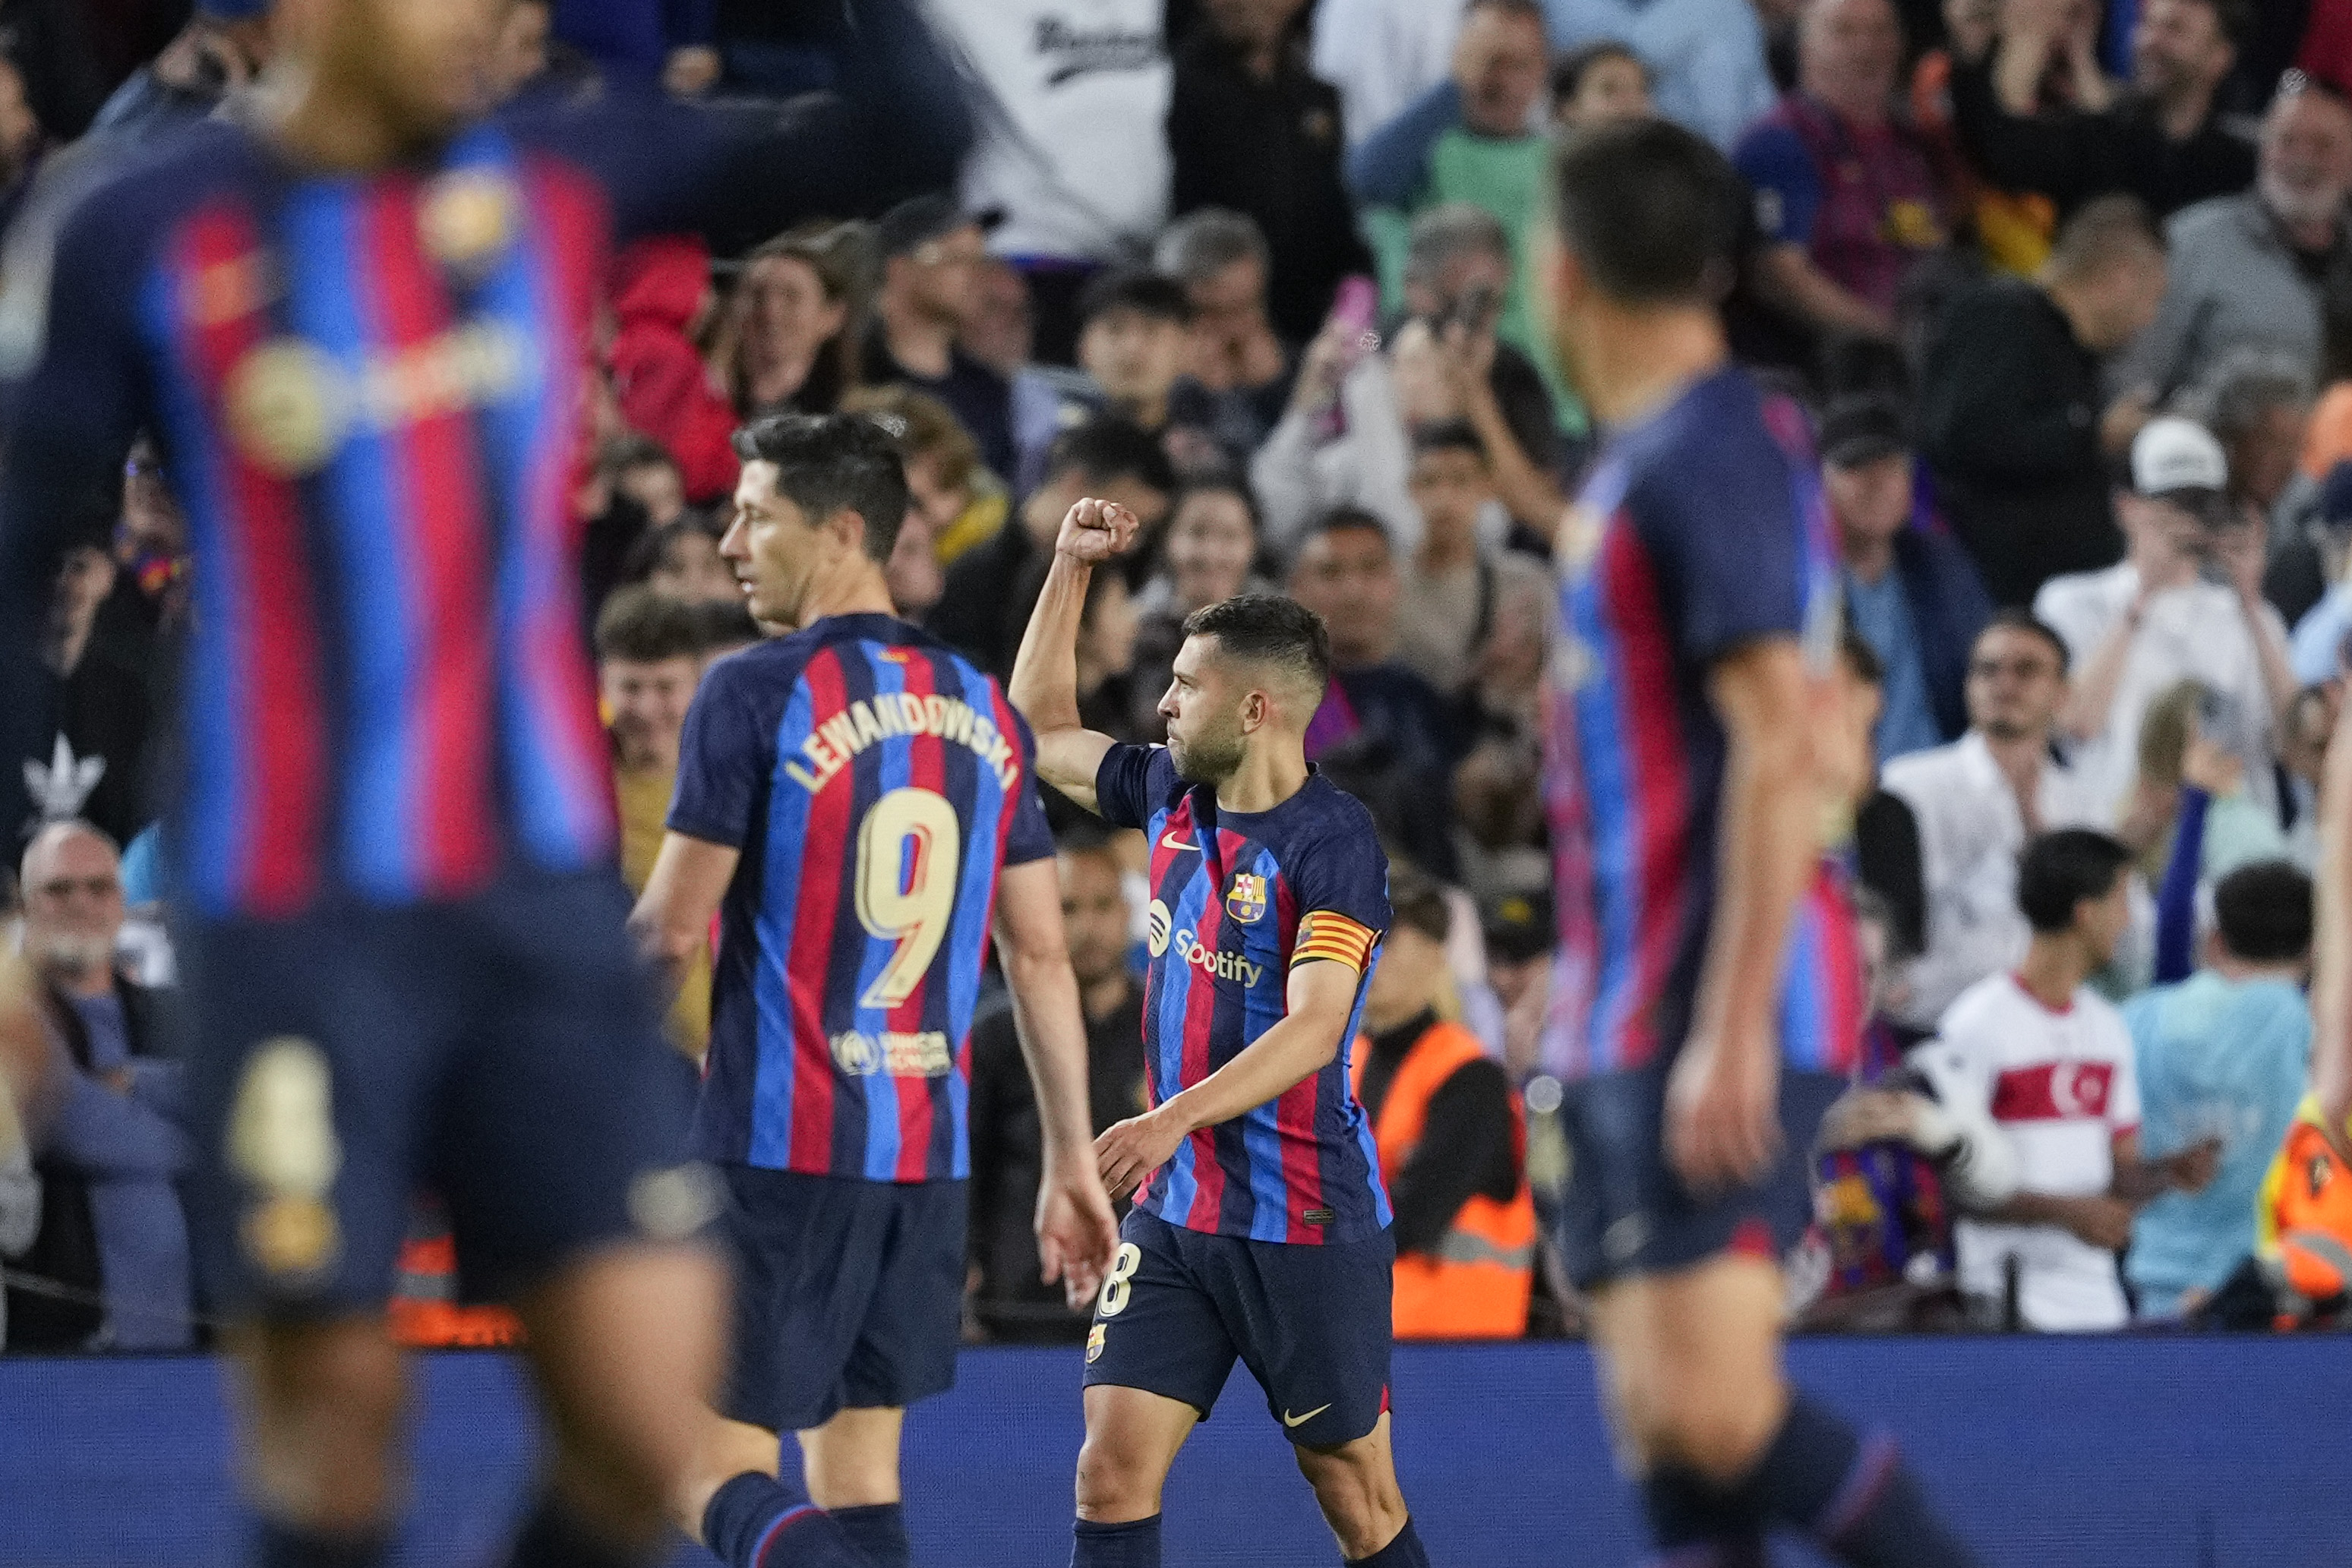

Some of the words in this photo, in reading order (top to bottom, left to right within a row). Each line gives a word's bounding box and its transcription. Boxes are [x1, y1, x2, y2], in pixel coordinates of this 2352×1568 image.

[785, 692, 1019, 793] LEWANDOWSKI
[855, 787, 959, 1008] 9
[1174, 929, 1263, 989] Spotify
